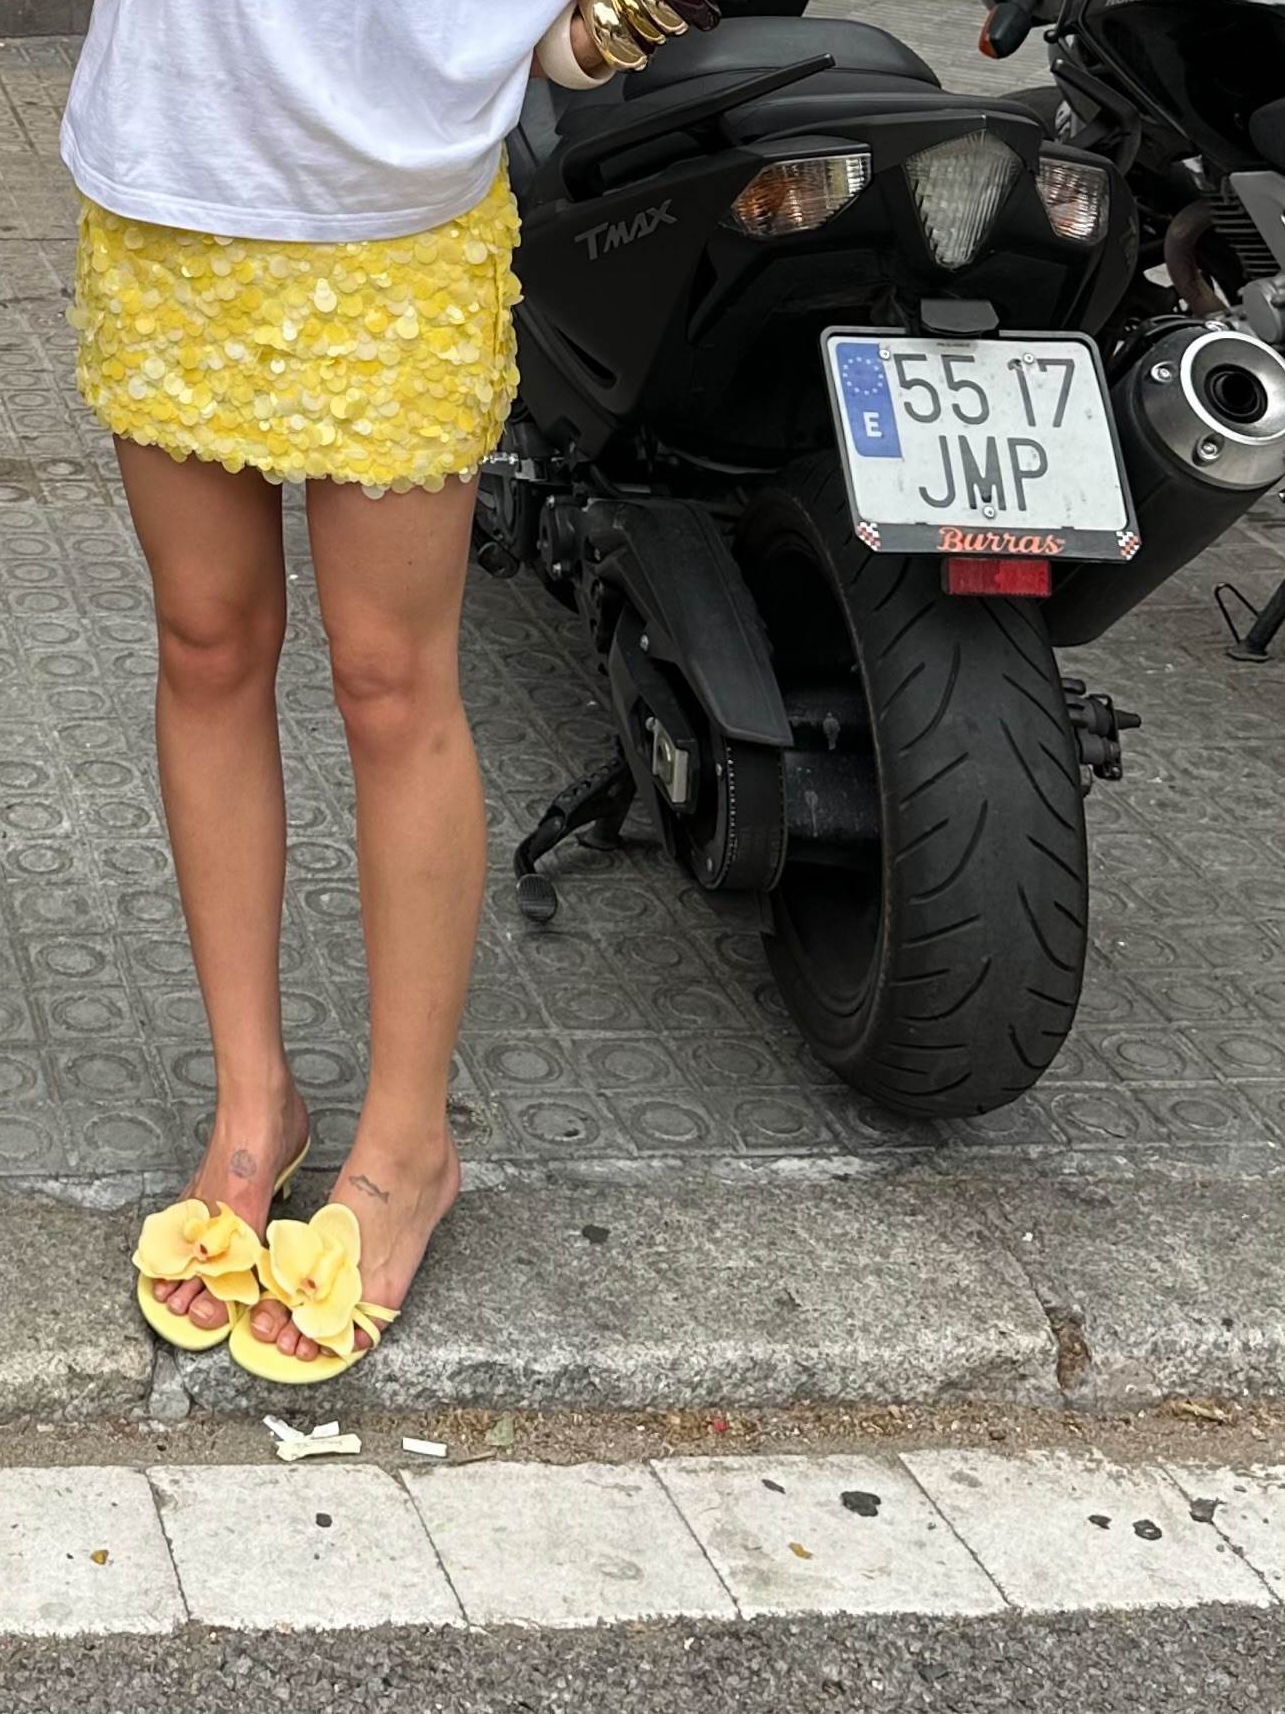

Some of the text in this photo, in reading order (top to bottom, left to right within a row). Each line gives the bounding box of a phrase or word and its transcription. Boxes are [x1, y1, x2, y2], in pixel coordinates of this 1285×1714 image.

[862, 411, 883, 438] E
[918, 434, 1049, 512] JMP
[937, 525, 1066, 555] Burras
